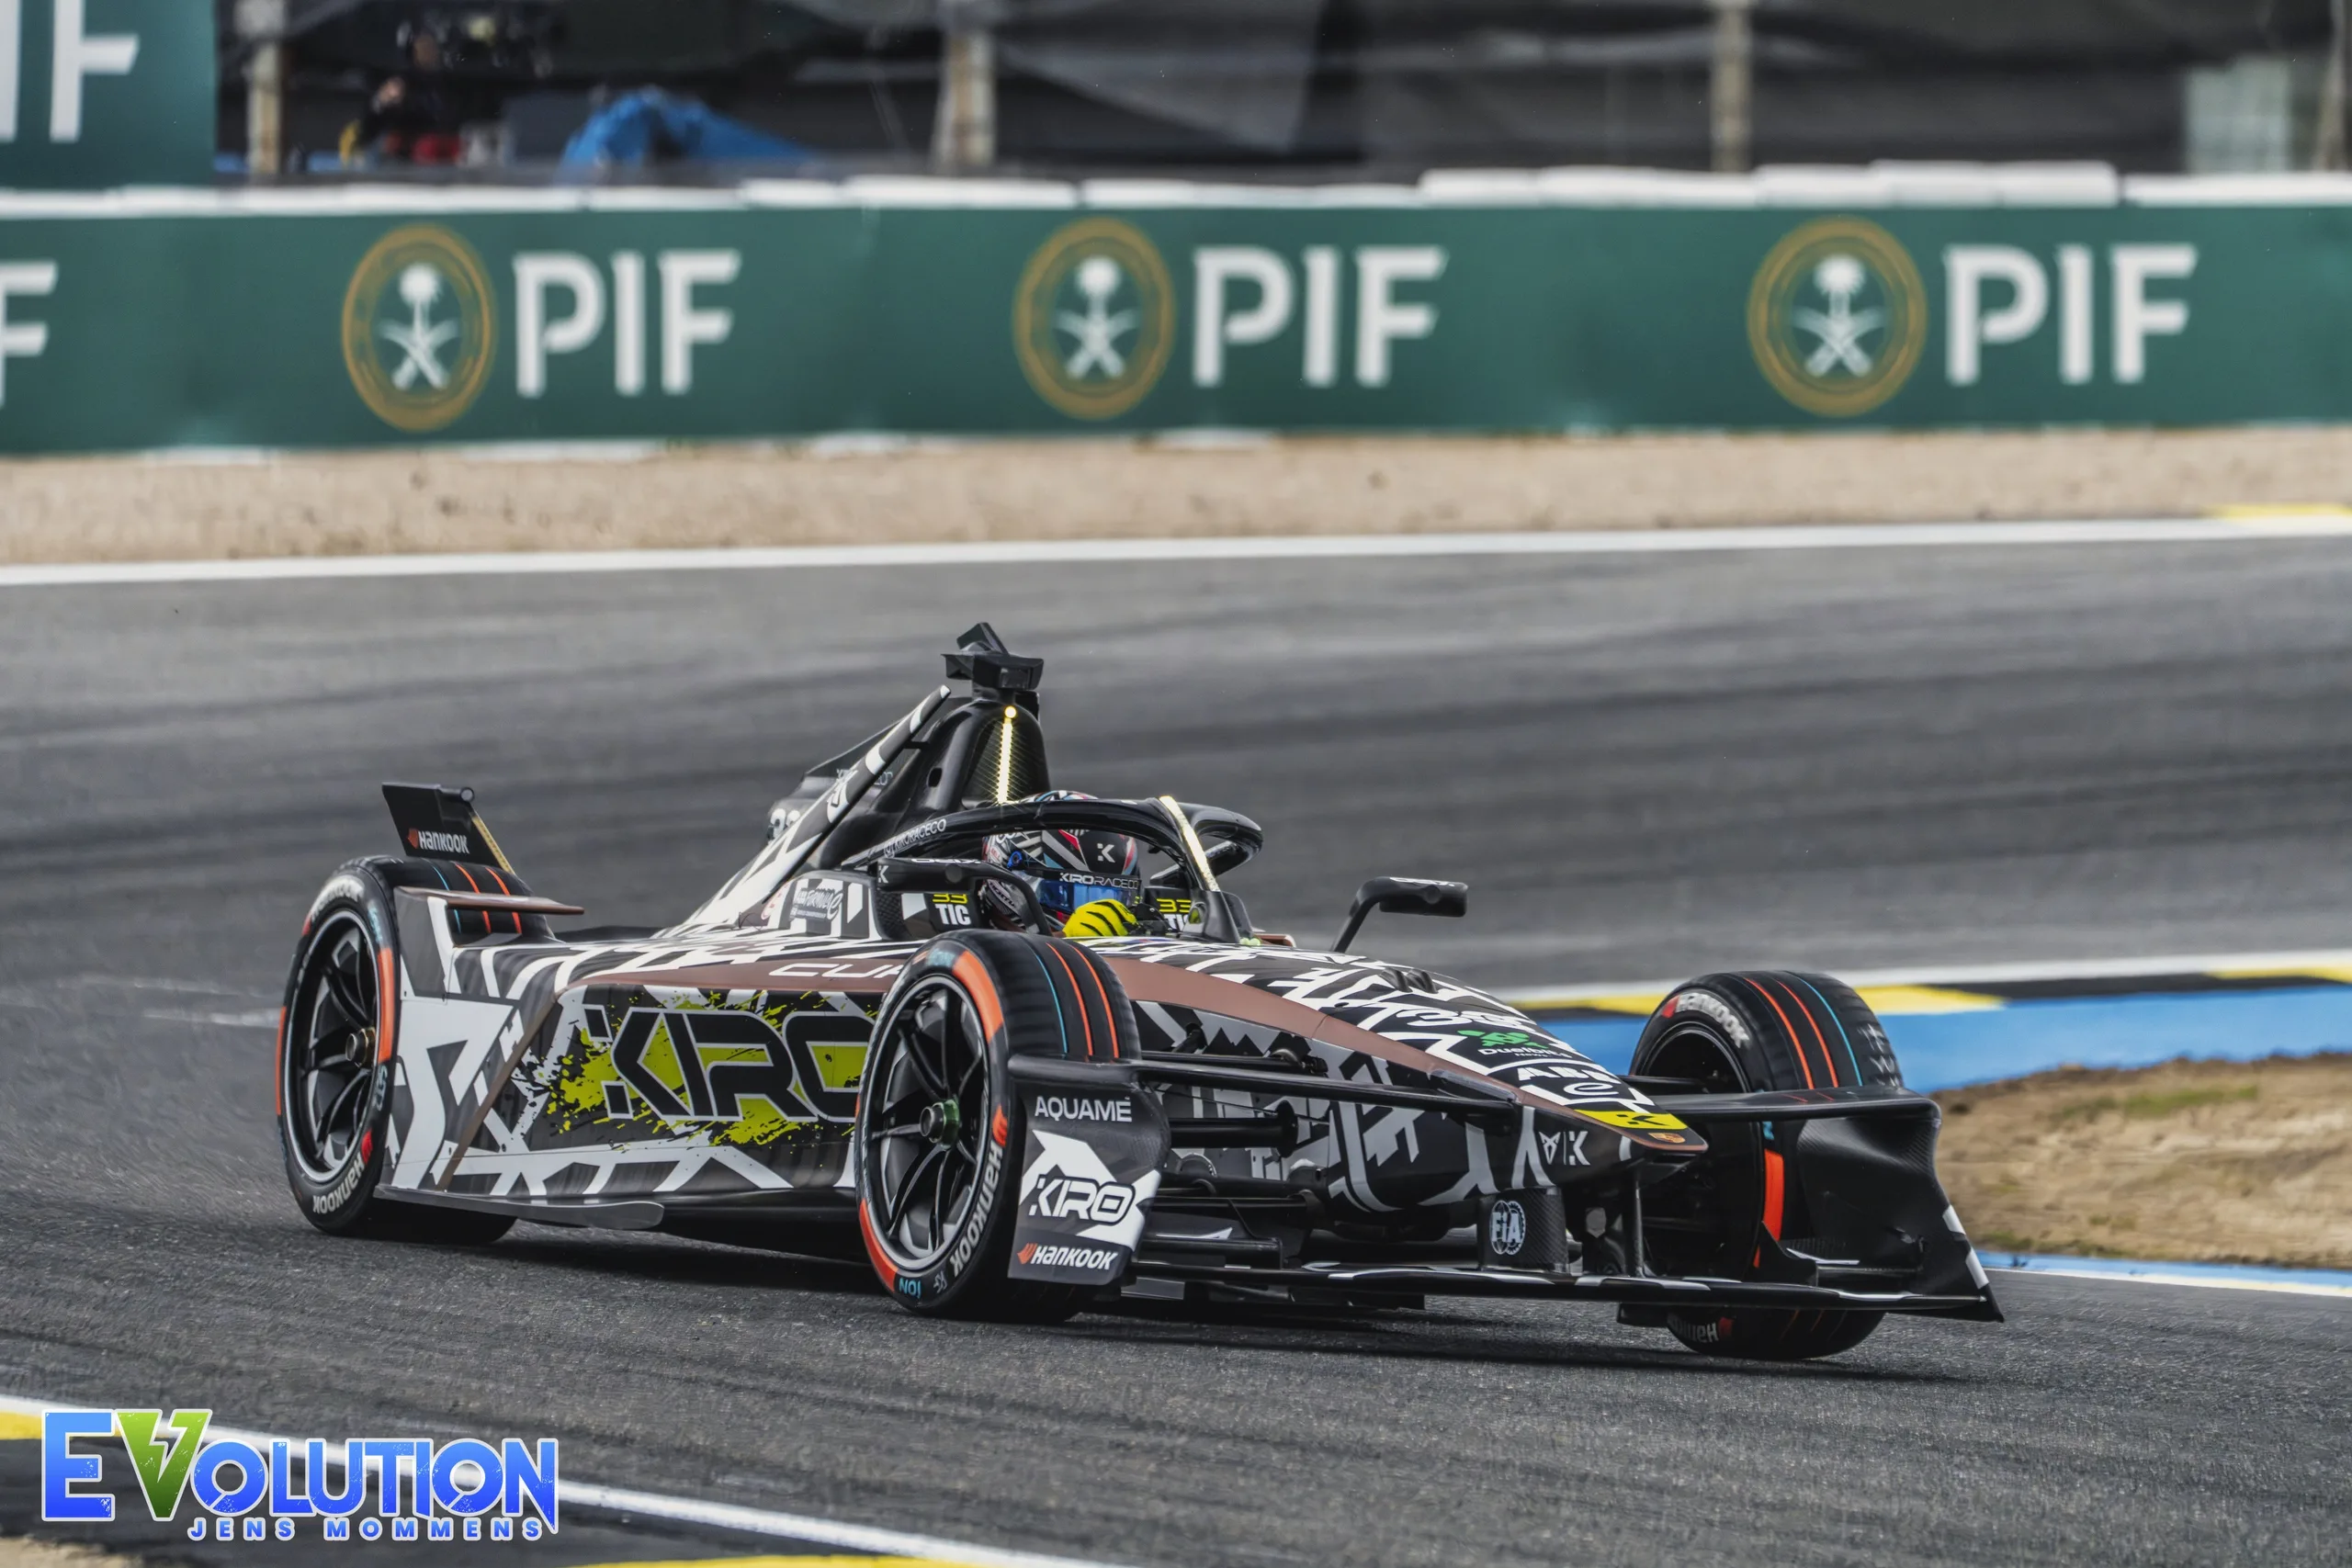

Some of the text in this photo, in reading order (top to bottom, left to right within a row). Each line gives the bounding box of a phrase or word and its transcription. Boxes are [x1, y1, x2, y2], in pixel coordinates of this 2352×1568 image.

[514, 250, 741, 397] PIF
[1193, 243, 1449, 388] PIF
[1944, 243, 2199, 386] PIF
[935, 904, 971, 926] TIC
[1028, 1177, 1133, 1223] KIRO
